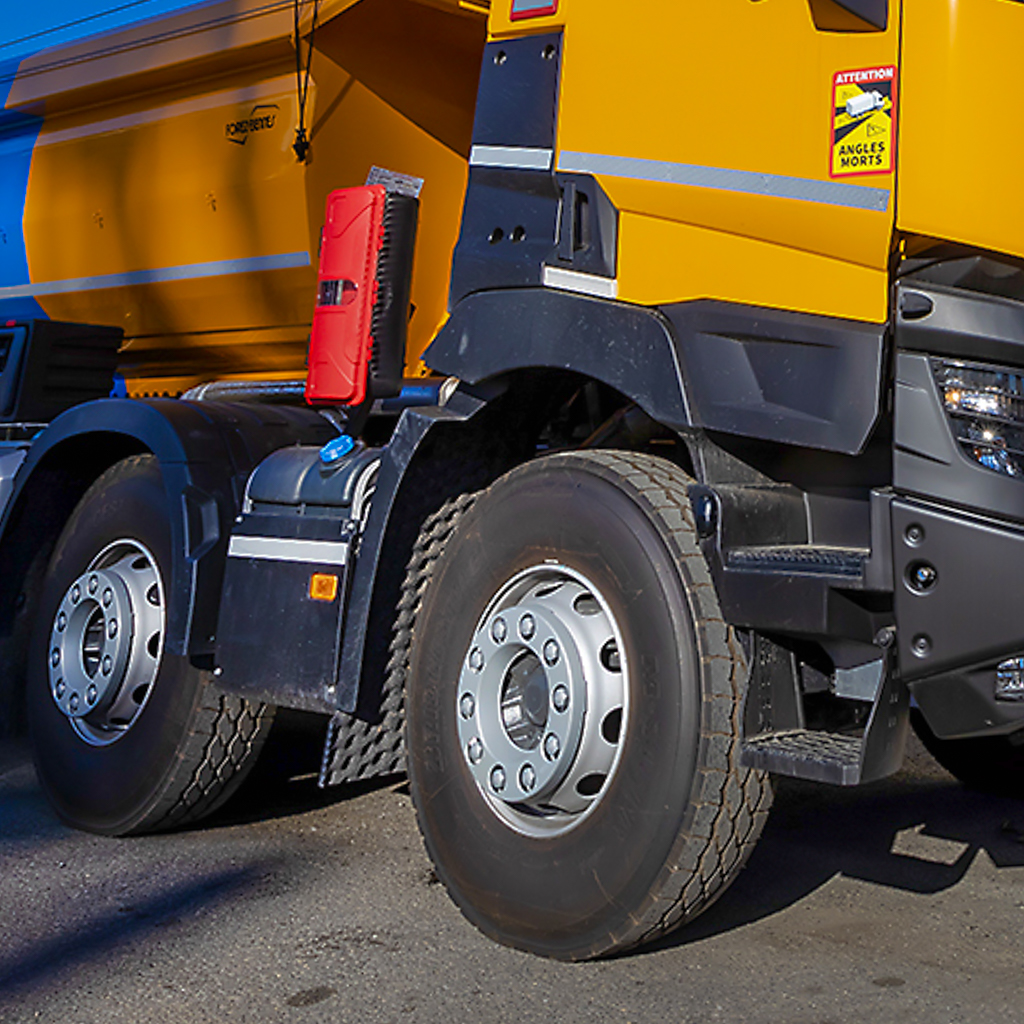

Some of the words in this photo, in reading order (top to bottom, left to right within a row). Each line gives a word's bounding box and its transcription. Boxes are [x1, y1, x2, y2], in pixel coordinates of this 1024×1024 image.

[835, 67, 894, 84] ATTENTION
[839, 141, 885, 155] ANGLES
[840, 153, 882, 168] MORTS
